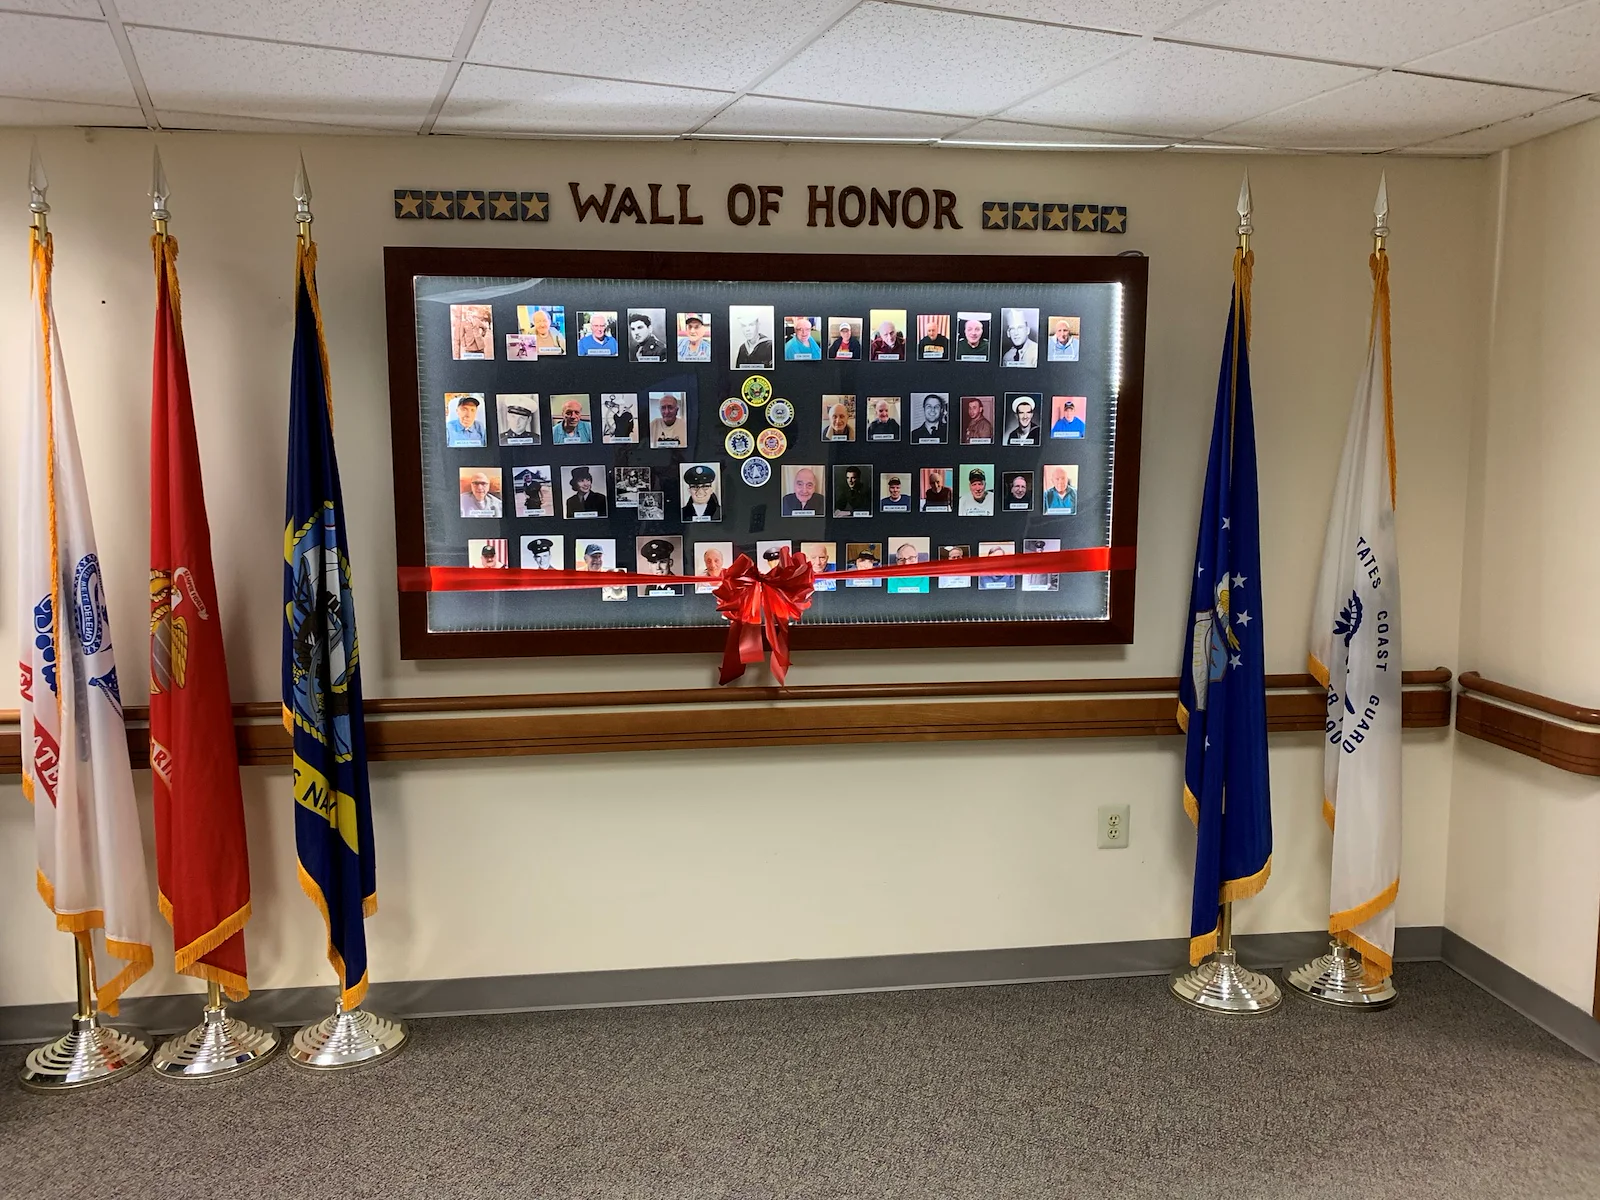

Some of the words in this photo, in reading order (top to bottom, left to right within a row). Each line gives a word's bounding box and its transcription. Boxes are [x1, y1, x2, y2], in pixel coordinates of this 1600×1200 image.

[568, 182, 704, 225] WALL
[727, 183, 784, 226] OF
[806, 185, 964, 230] HONOR
[1375, 610, 1389, 672] COAST
[1342, 694, 1380, 754] GUARD
